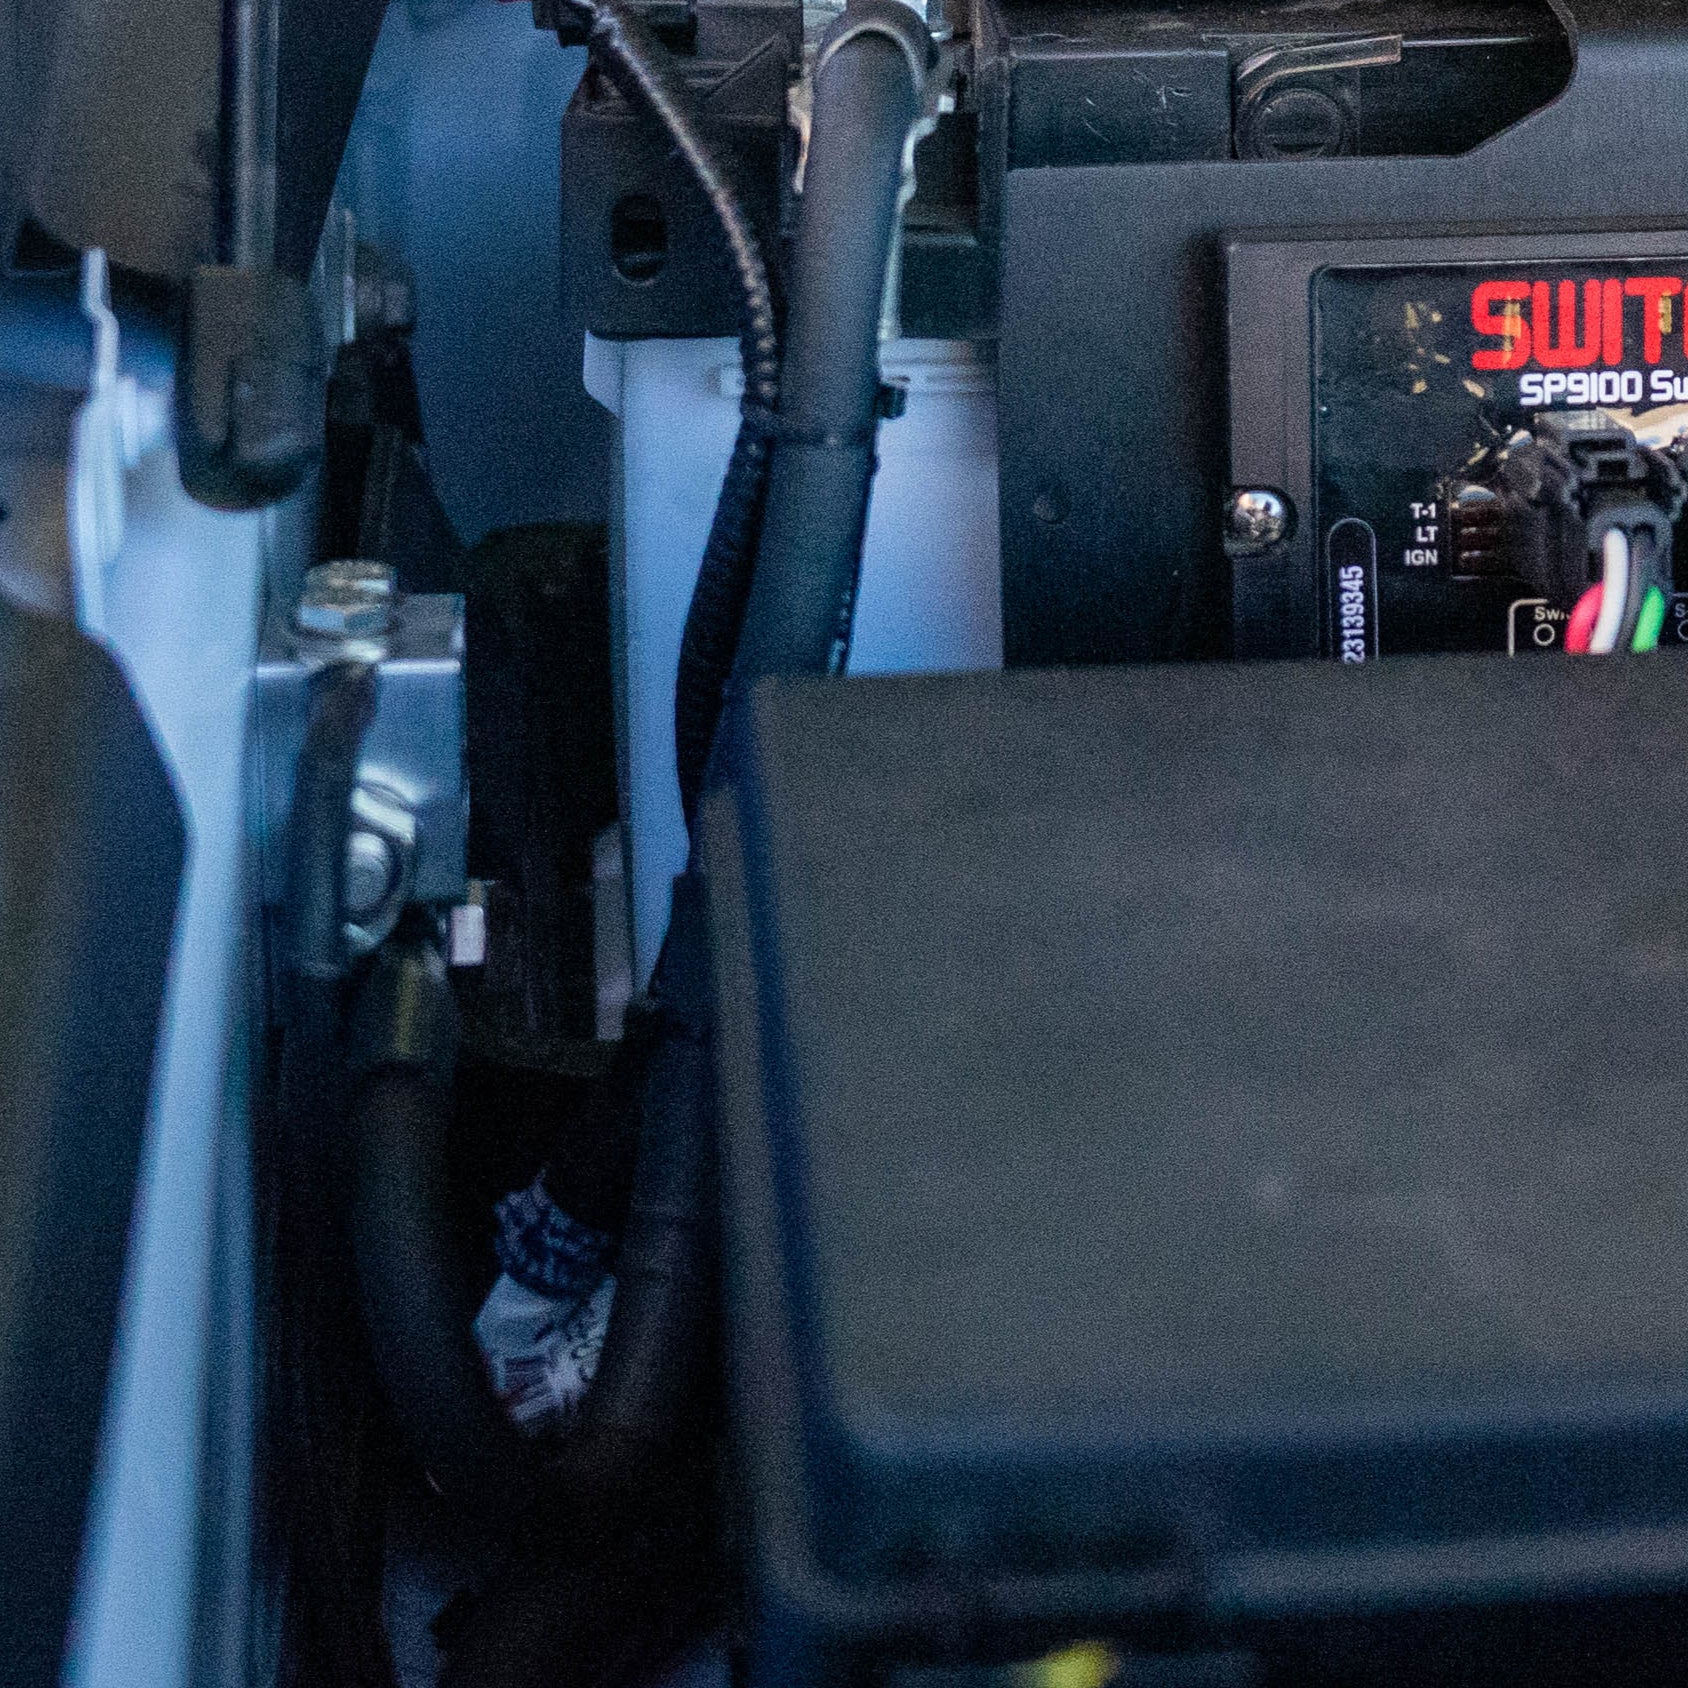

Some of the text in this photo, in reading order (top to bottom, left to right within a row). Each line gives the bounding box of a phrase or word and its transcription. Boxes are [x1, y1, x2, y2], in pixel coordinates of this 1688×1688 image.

[1519, 369, 1644, 407] SP9100
[1409, 502, 1437, 519] T-1
[1415, 525, 1438, 543] LT
[1403, 548, 1438, 566] IGN
